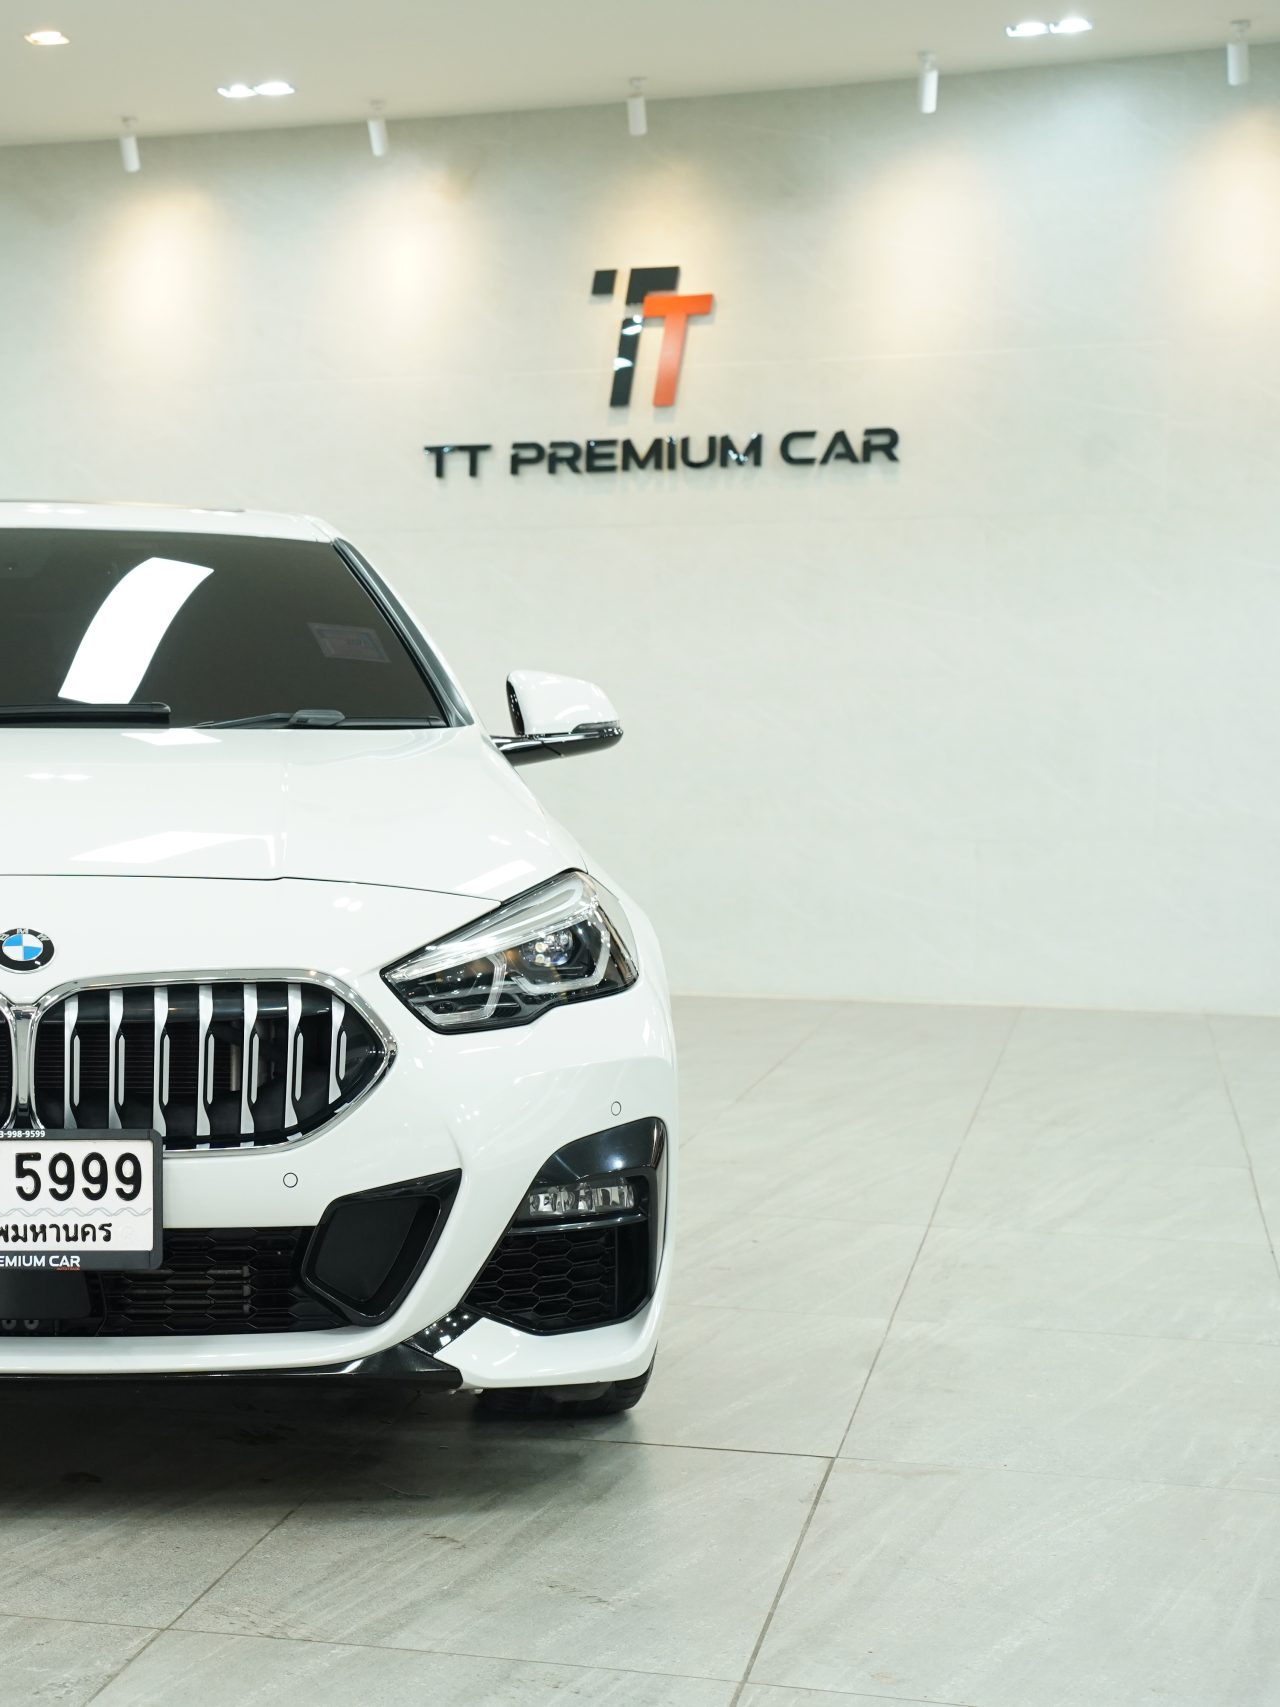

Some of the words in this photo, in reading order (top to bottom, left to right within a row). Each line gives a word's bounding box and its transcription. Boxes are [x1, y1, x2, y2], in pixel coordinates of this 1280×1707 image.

[423, 443, 492, 479] TT
[510, 434, 764, 476] PREMIUM
[779, 427, 900, 466] CAR
[15, 1151, 142, 1201] 5999
[48, 1255, 81, 1268] CAR
